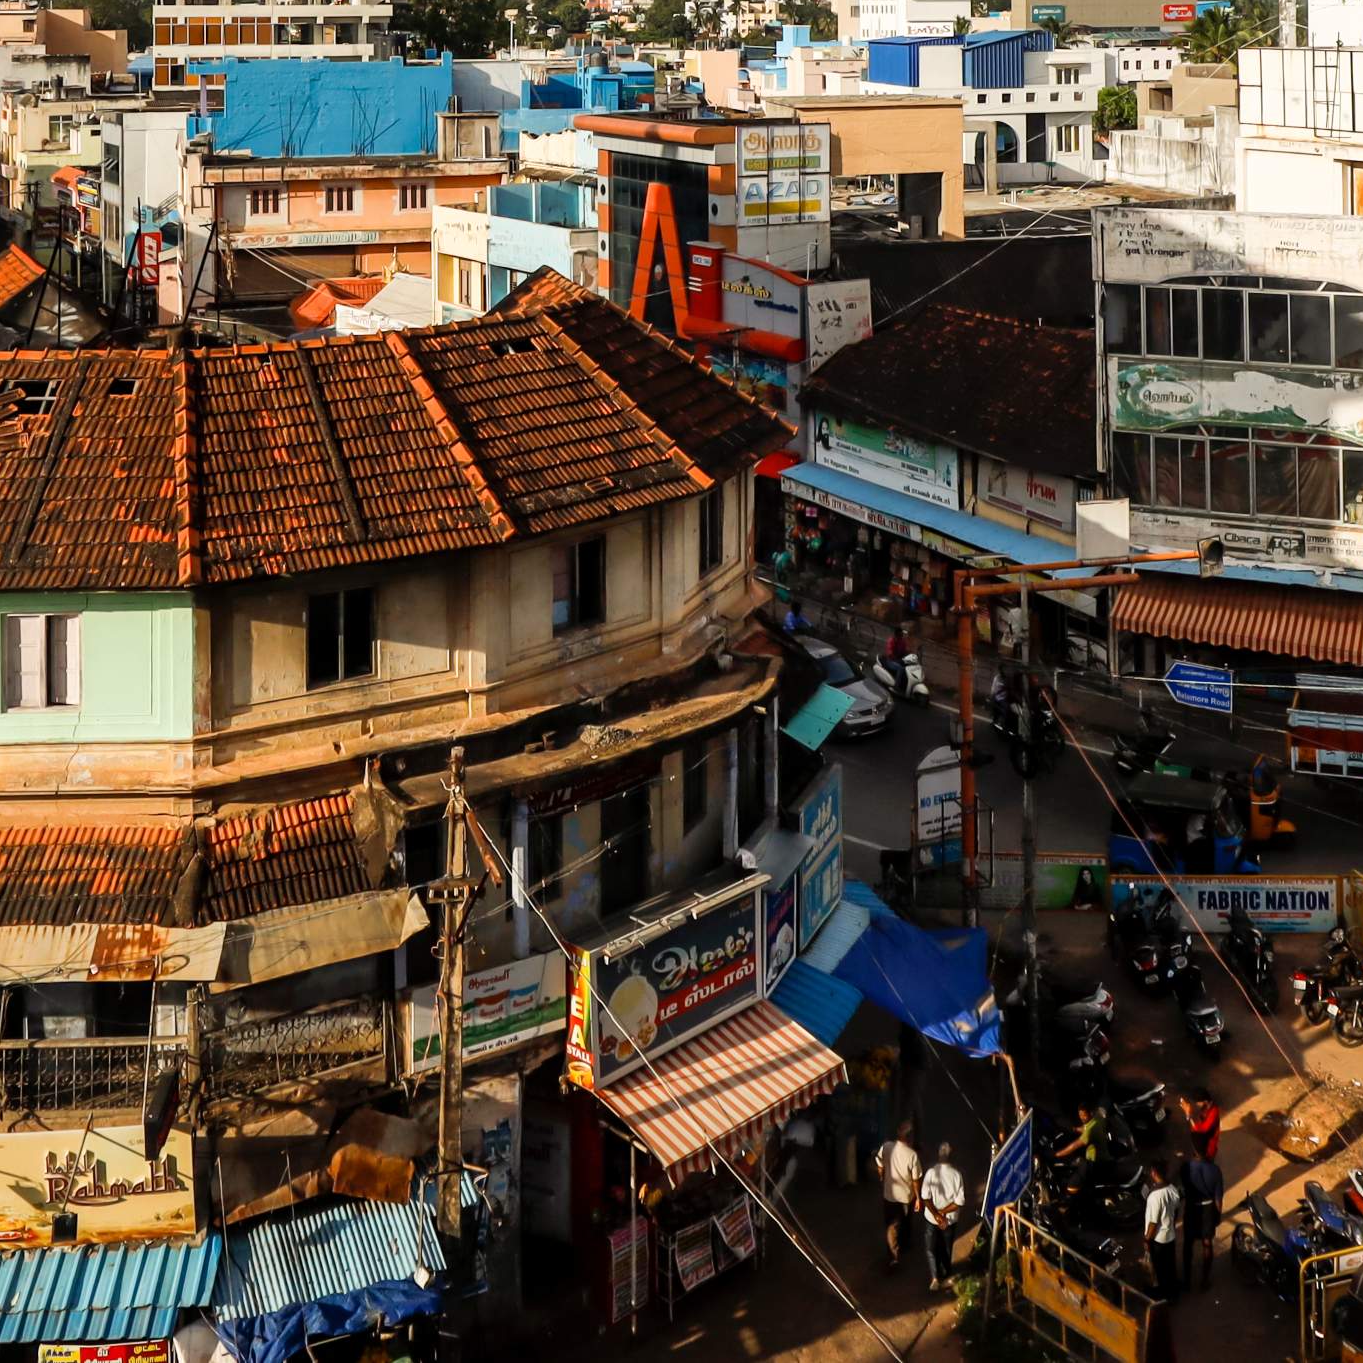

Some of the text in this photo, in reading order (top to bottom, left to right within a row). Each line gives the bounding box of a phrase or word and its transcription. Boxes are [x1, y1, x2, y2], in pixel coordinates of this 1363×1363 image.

[744, 180, 822, 200] AZAD
[1197, 890, 1331, 911] FABRIC NATION
[659, 1001, 679, 1022] டீ
[684, 958, 755, 1008] ஸ்டால்
[566, 1042, 592, 1065] STALL
[43, 1154, 182, 1206] Rahmath
